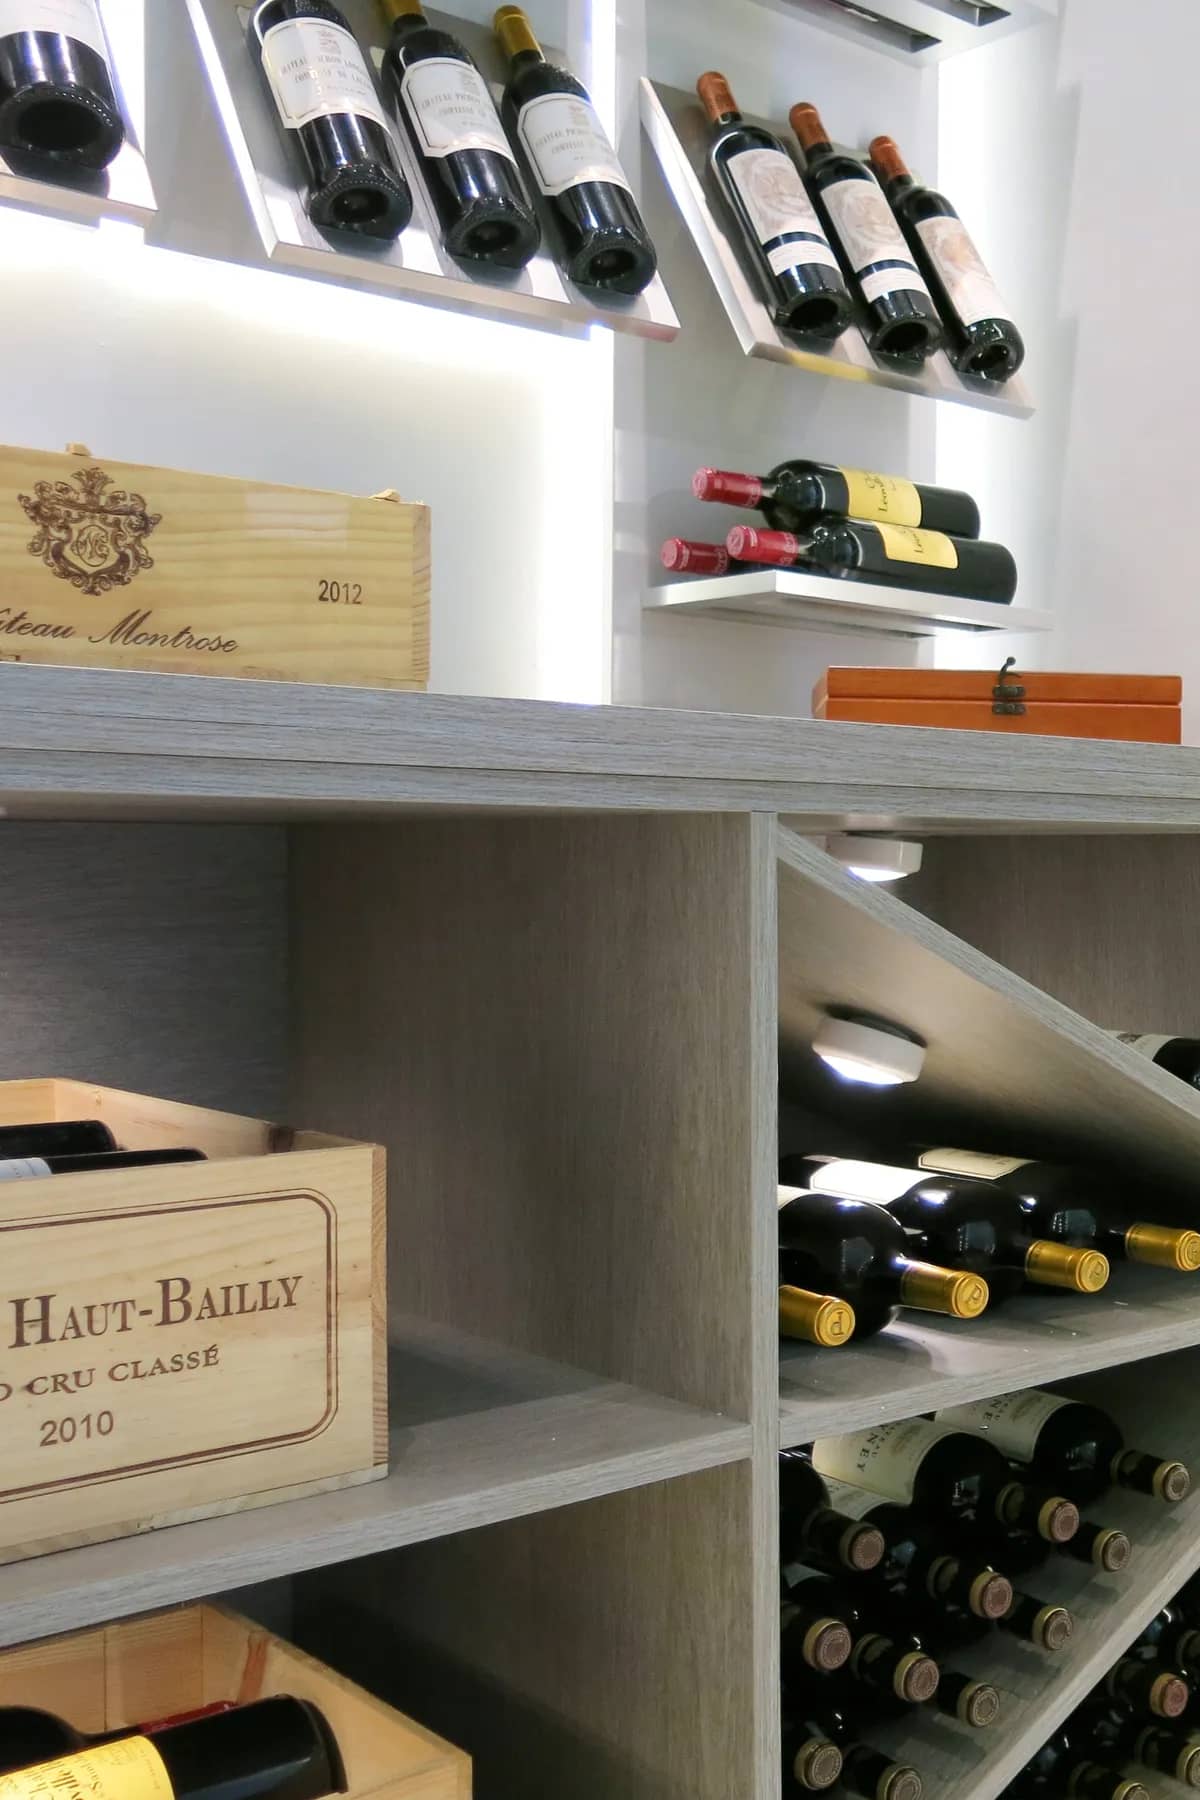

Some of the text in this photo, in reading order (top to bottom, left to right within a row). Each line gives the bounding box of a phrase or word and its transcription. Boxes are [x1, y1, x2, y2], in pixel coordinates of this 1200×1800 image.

[318, 579, 362, 605] 2012
[88, 608, 239, 653] Montrose
[8, 1275, 304, 1349] HAUT-BAILLY
[25, 1368, 96, 1396] CRU
[108, 1344, 220, 1382] CLASSÉ
[39, 1410, 114, 1447] 2010
